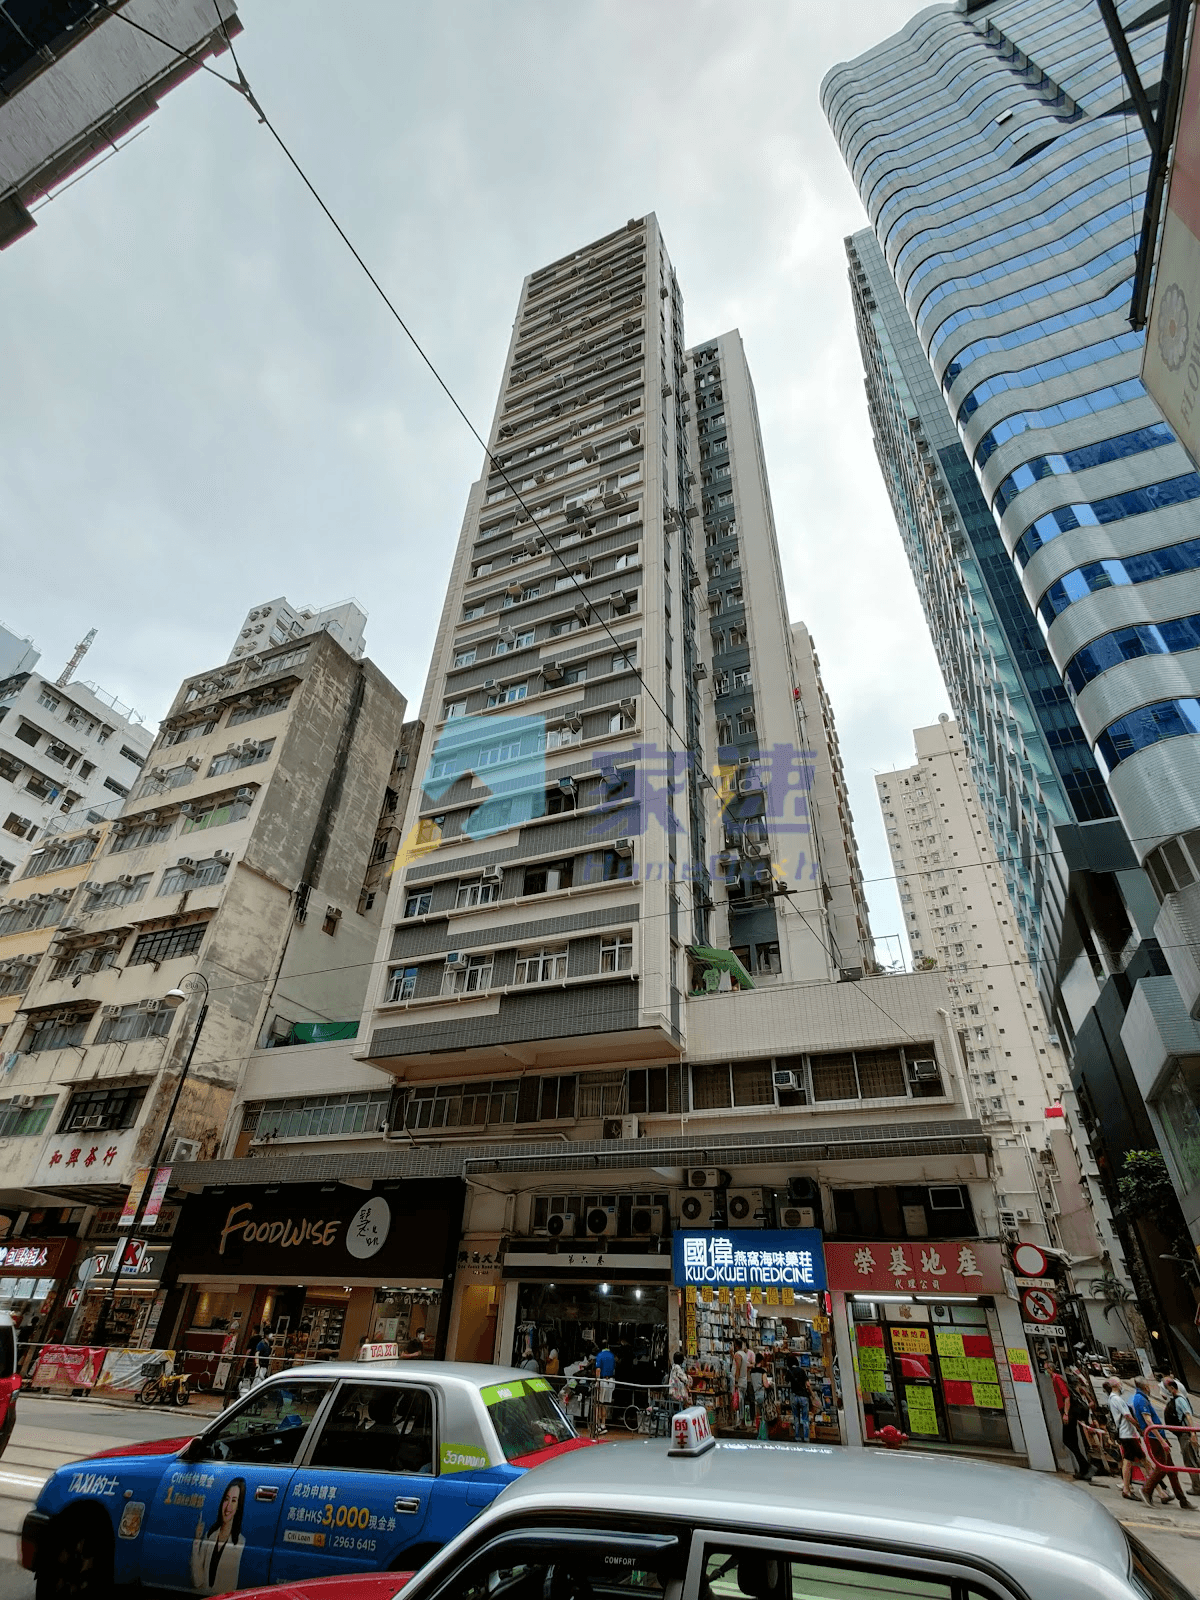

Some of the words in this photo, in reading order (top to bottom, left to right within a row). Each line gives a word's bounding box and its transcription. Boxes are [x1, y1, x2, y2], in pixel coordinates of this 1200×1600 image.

[49, 1146, 118, 1168] 和興茶行
[853, 1245, 983, 1277] 榮基地產
[750, 1266, 814, 1283] MEDICINE
[894, 1278, 940, 1290] 代理公司
[1054, 1327, 1064, 1335] 10
[371, 1344, 397, 1358] TAXI
[674, 1419, 688, 1449] 的士
[292, 1482, 337, 1500] 成功申請享
[297, 1533, 311, 1542] Loan
[333, 1536, 354, 1549] 2963
[357, 1539, 377, 1551] 6415
[604, 1555, 637, 1566] COMFORT
